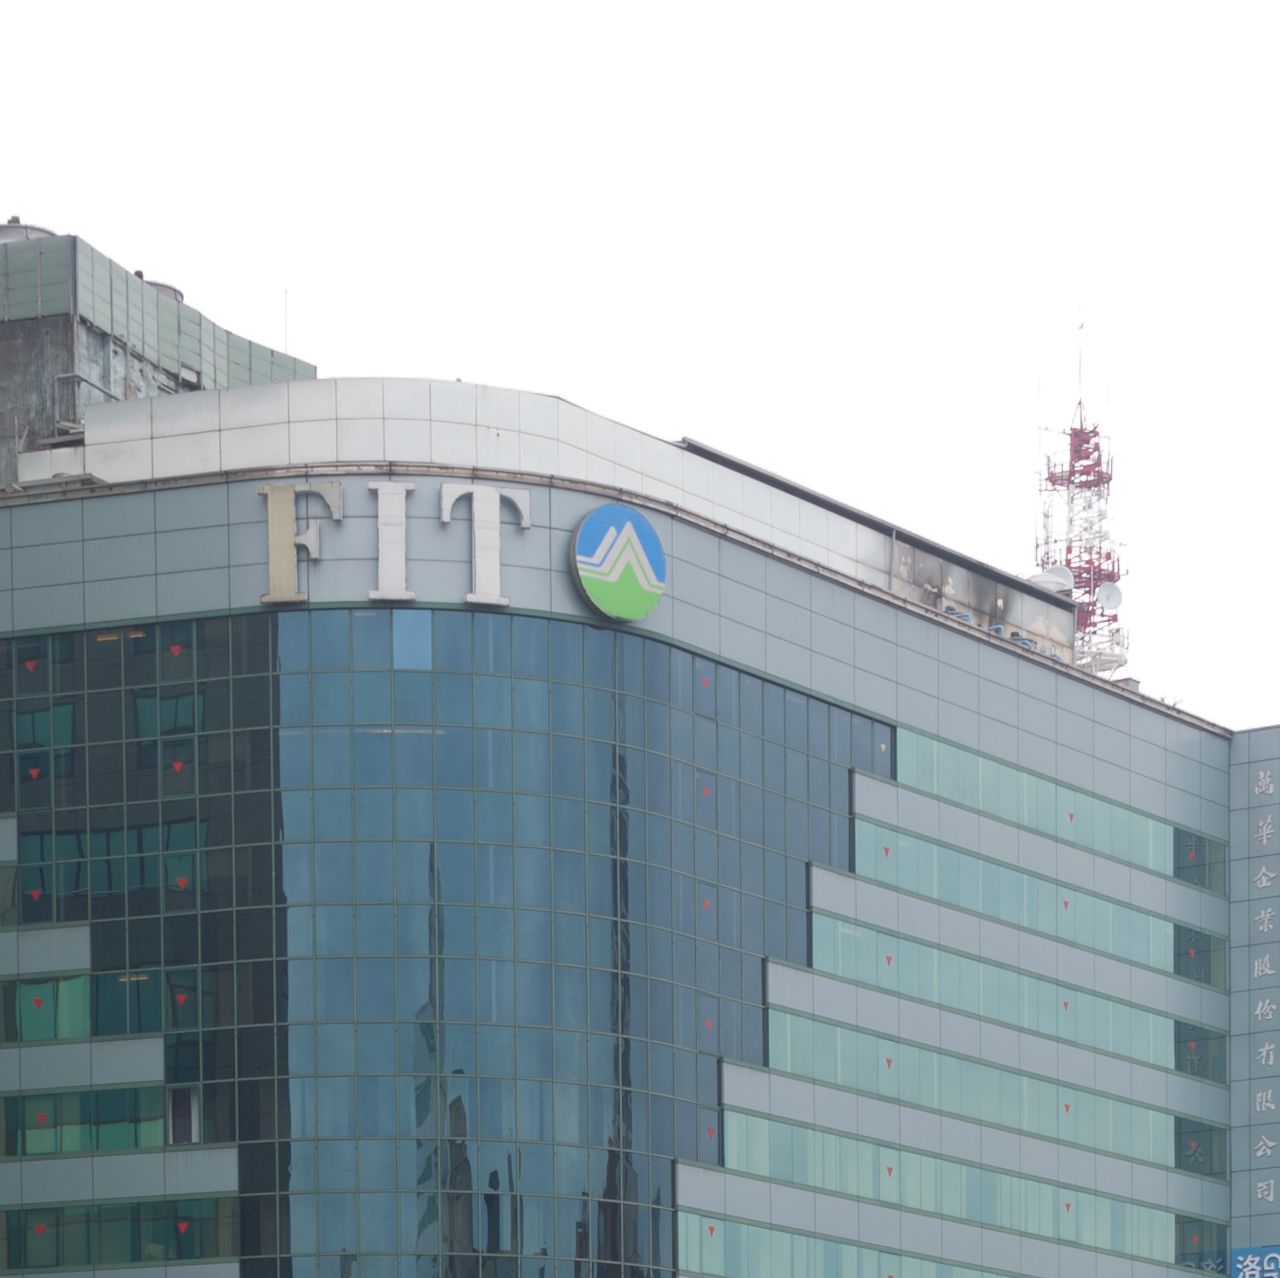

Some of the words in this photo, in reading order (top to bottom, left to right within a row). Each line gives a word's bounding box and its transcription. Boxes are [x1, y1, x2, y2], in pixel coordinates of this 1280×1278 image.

[258, 480, 532, 606] FIT
[1253, 769, 1278, 1203] 萬華企業股份有限公司
